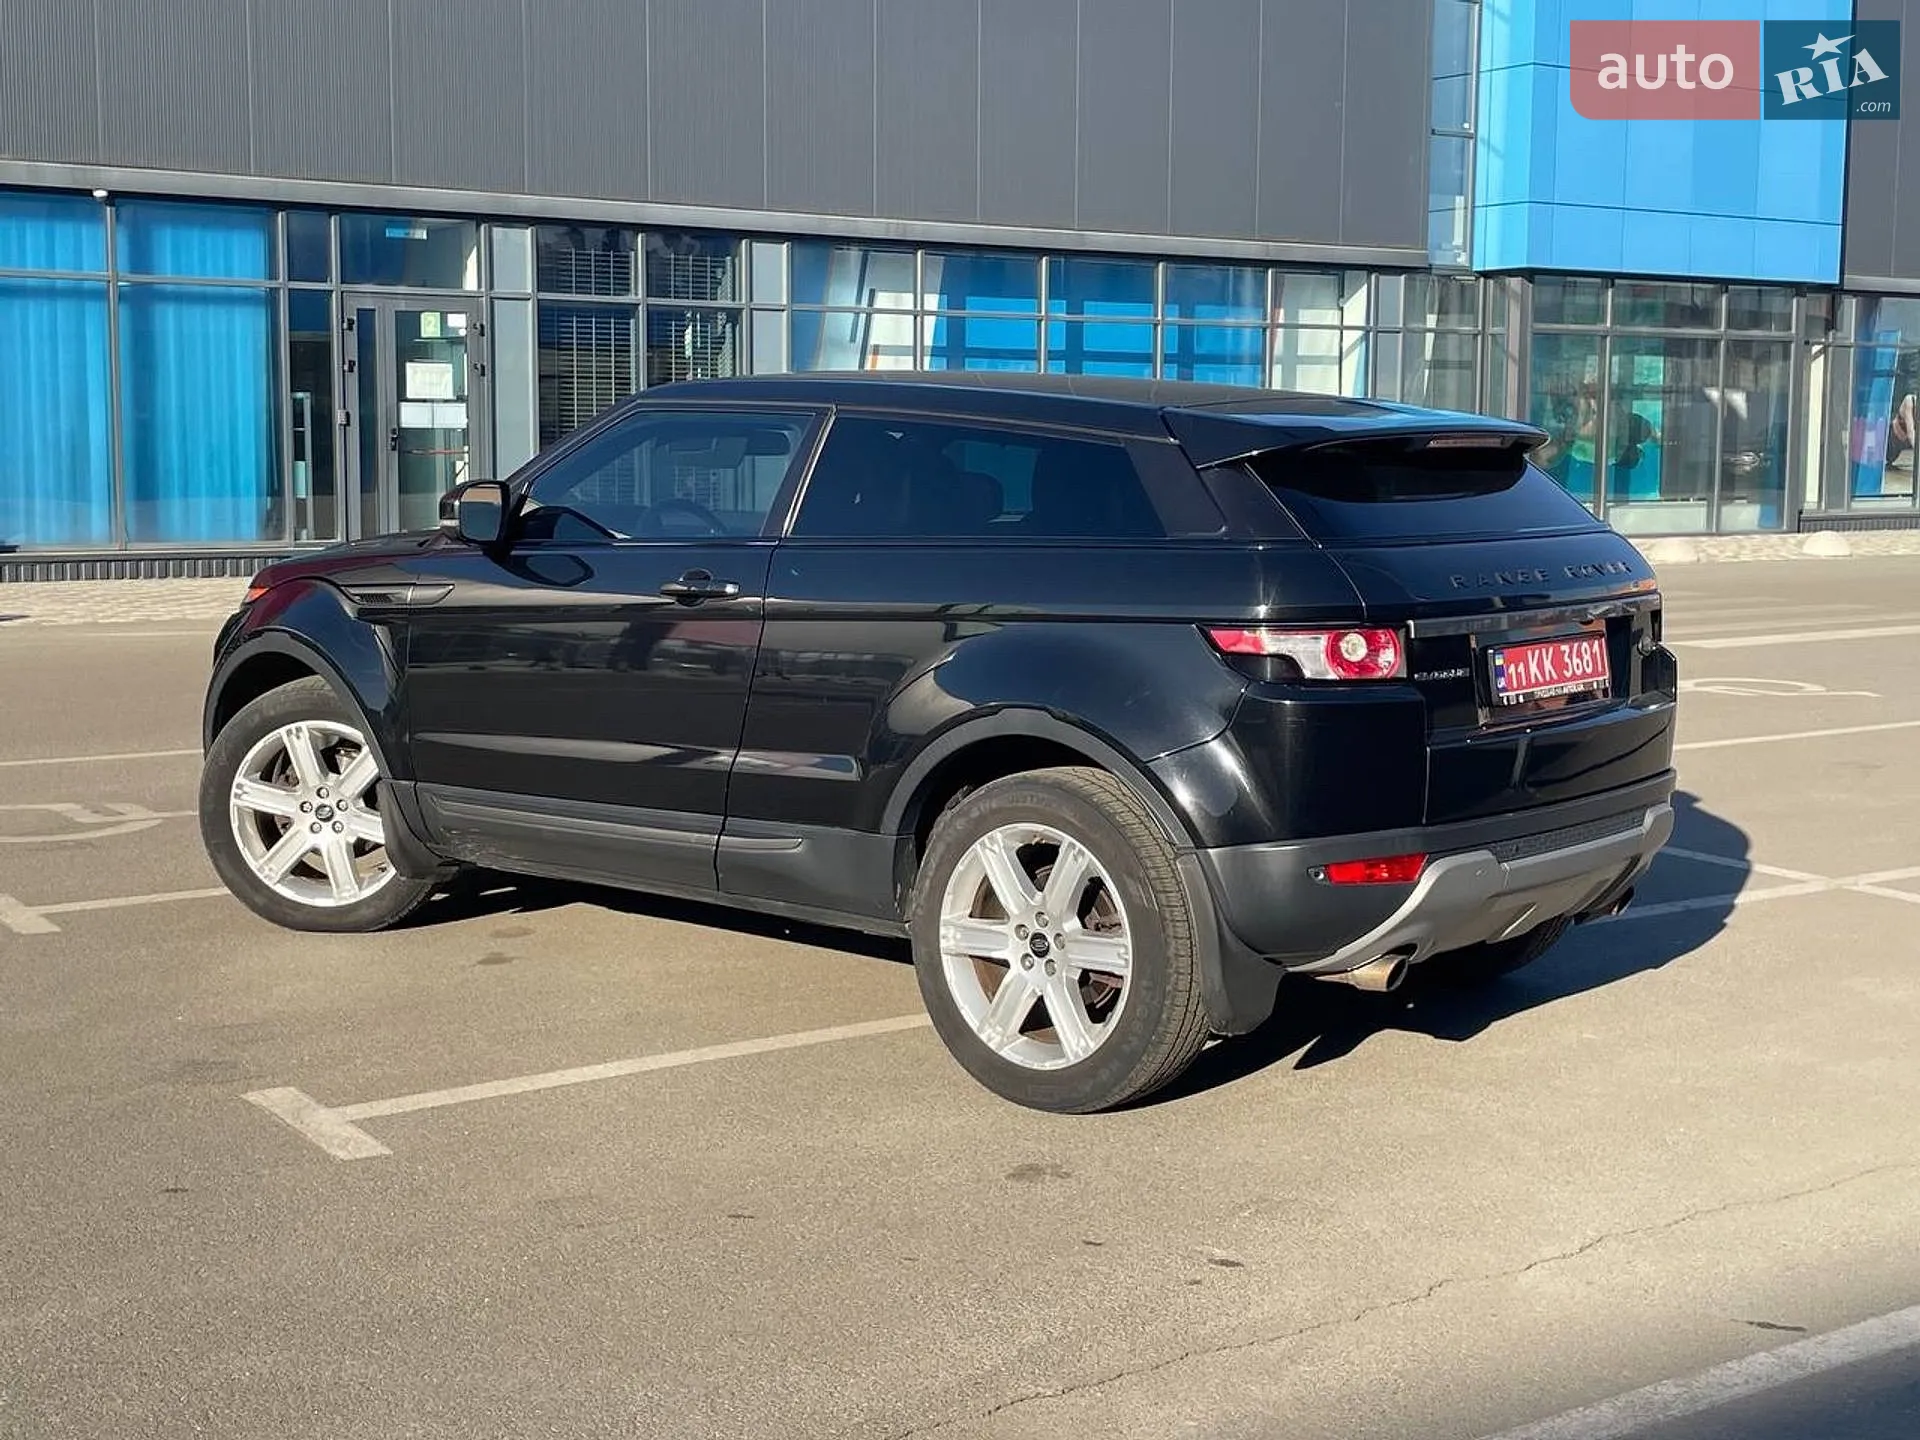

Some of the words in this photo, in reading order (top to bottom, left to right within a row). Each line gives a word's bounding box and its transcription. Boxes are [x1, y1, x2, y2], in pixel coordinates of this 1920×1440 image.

[1450, 568, 1549, 589] RANGE
[1564, 561, 1632, 579] ROVER
[1561, 639, 1603, 678] 3681
